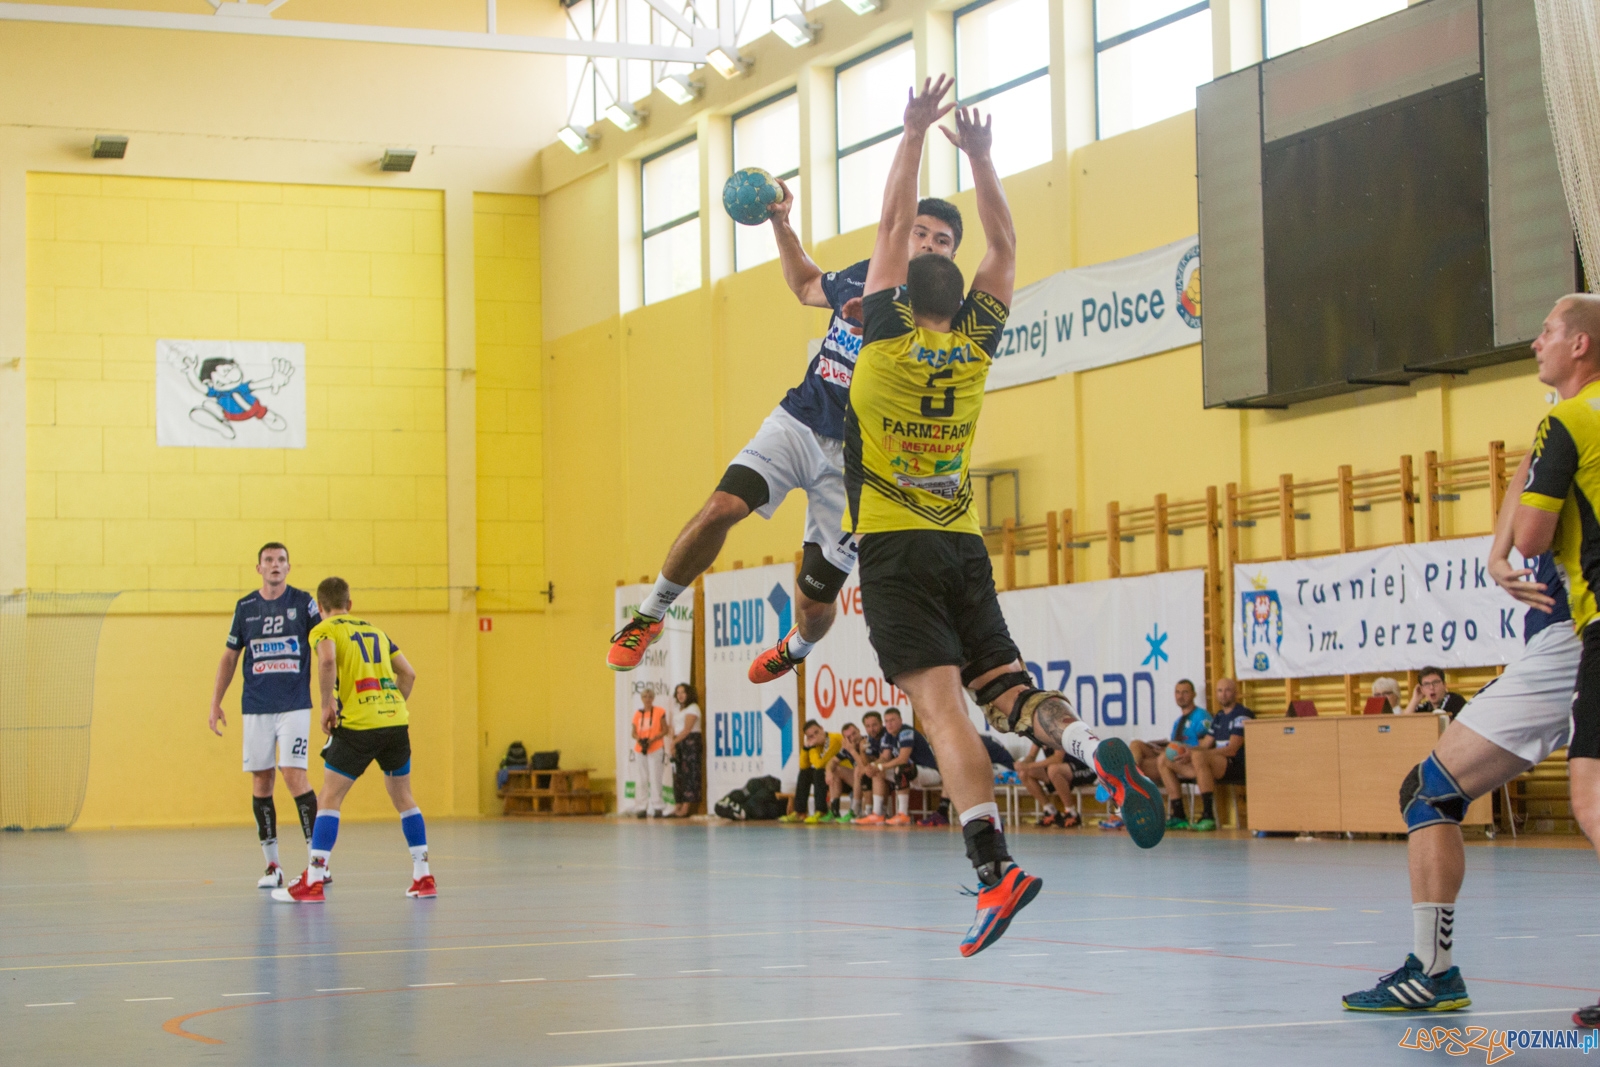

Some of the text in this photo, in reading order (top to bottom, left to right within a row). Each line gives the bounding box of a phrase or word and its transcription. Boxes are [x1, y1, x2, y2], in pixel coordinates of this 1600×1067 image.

[1055, 311, 1074, 343] w
[1081, 288, 1165, 337] Polsce
[917, 343, 982, 369] REAL
[805, 574, 825, 591] SELECT
[1297, 563, 1406, 605] Turniej
[1424, 556, 1500, 592] Piłk
[262, 615, 284, 634] 22
[713, 597, 764, 648] ELBUD
[1307, 607, 1517, 652] im. Jerzego K
[253, 642, 285, 654] ELBUD
[350, 631, 381, 664] 17
[267, 662, 298, 671] VEOLIA
[291, 737, 307, 756] 22
[715, 710, 763, 757] ELBUD
